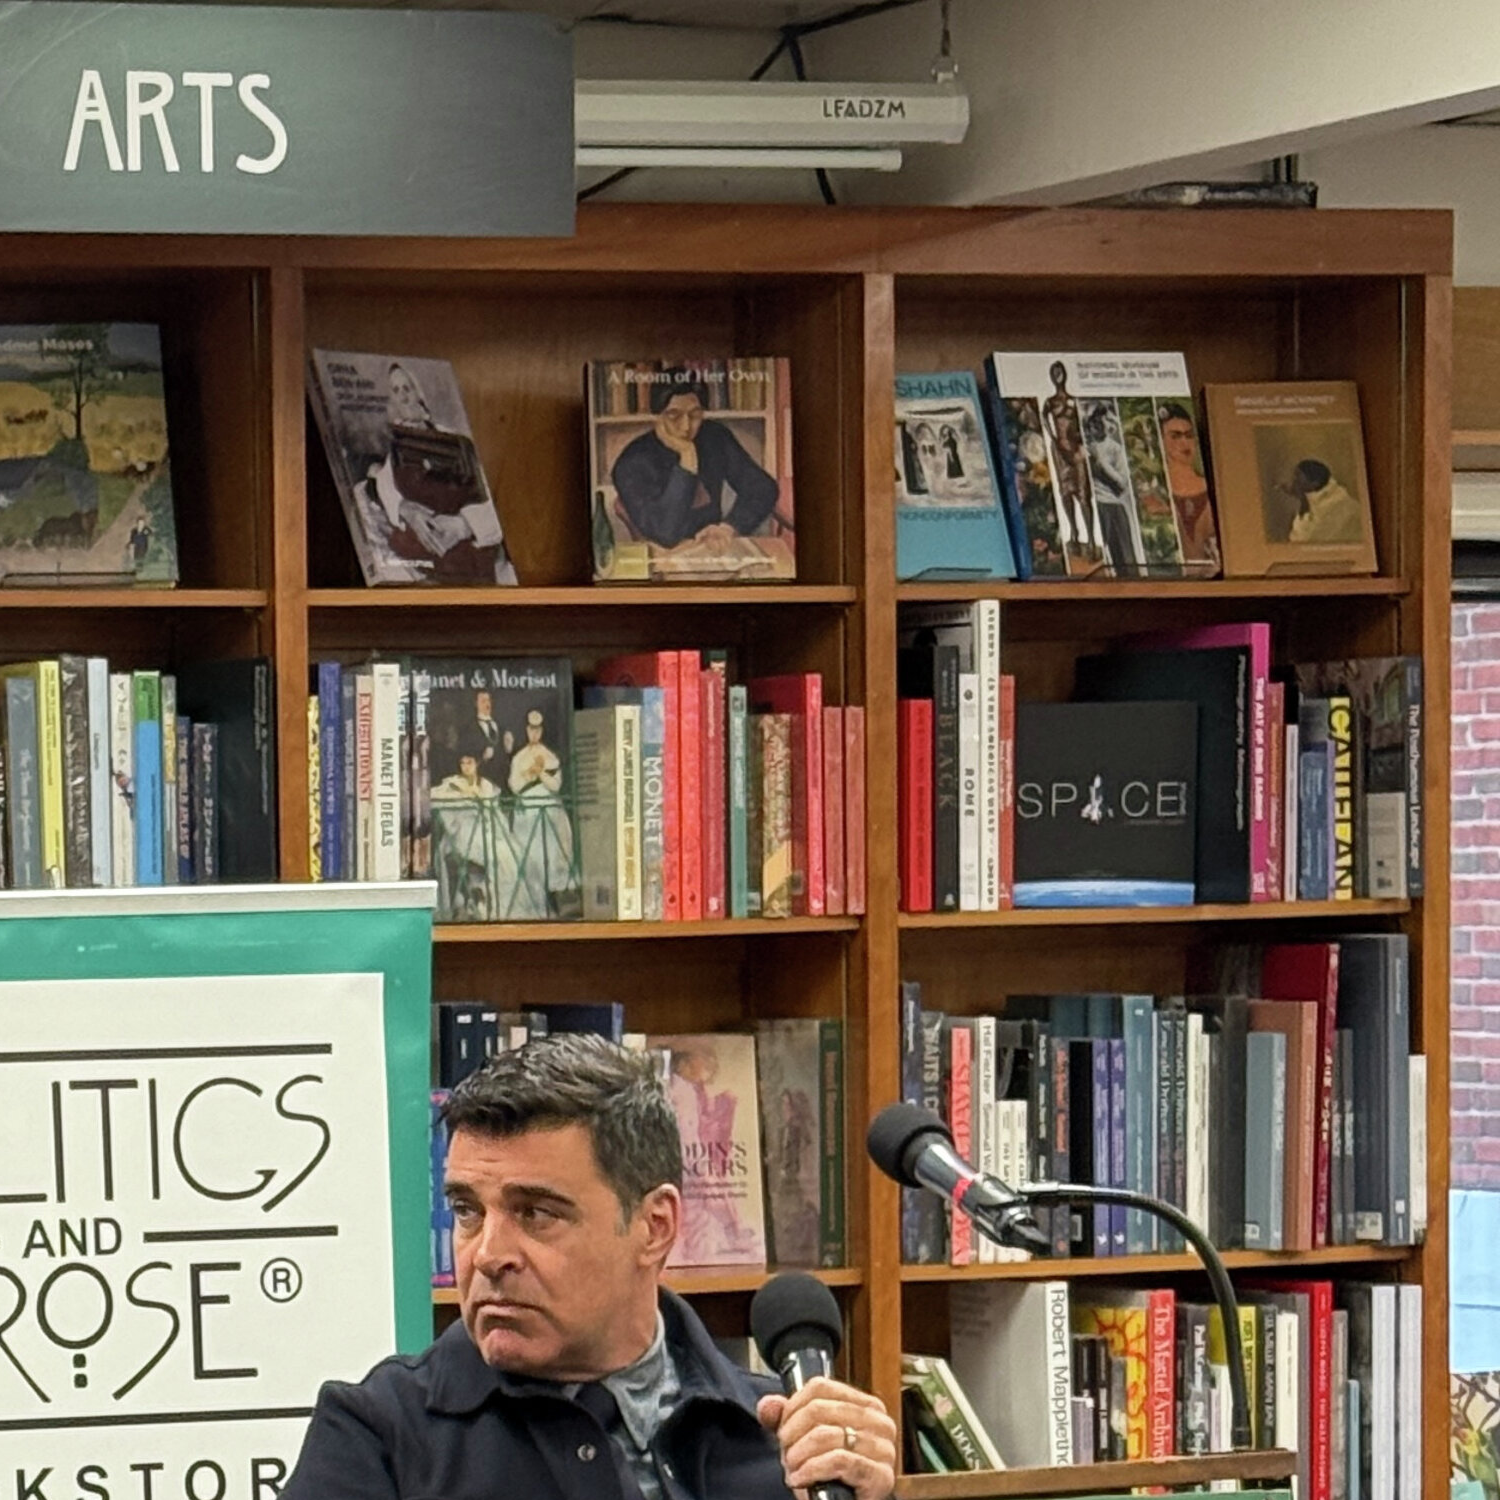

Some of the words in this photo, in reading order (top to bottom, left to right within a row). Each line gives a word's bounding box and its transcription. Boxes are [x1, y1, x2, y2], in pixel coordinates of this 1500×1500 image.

[62, 68, 289, 175] ARTS
[42, 338, 94, 351] Moses
[608, 371, 620, 383] A
[624, 369, 672, 384] Room
[675, 368, 691, 383] of
[694, 368, 724, 383] Her
[728, 367, 771, 383] Own
[895, 376, 974, 399] SHAHN
[412, 670, 466, 690] anet
[470, 671, 487, 690] &
[491, 668, 559, 691] Morisot
[1408, 703, 1422, 727] The
[380, 737, 395, 789] MANET
[938, 713, 956, 810] BLACK
[643, 755, 664, 846] MONET
[964, 767, 975, 818] ROME
[380, 801, 395, 849] DEGAS
[923, 1031, 940, 1083] WAITS
[982, 1025, 993, 1048] Hal
[982, 1049, 993, 1095] Fischer
[682, 1158, 749, 1178] NCERS
[684, 1140, 749, 1161] DIN'S
[21, 1216, 123, 1258] AND
[1050, 1288, 1068, 1358] Robert
[1152, 1302, 1171, 1337] The
[1051, 1365, 1070, 1465] Mappleth
[950, 1423, 982, 1471] DOGS
